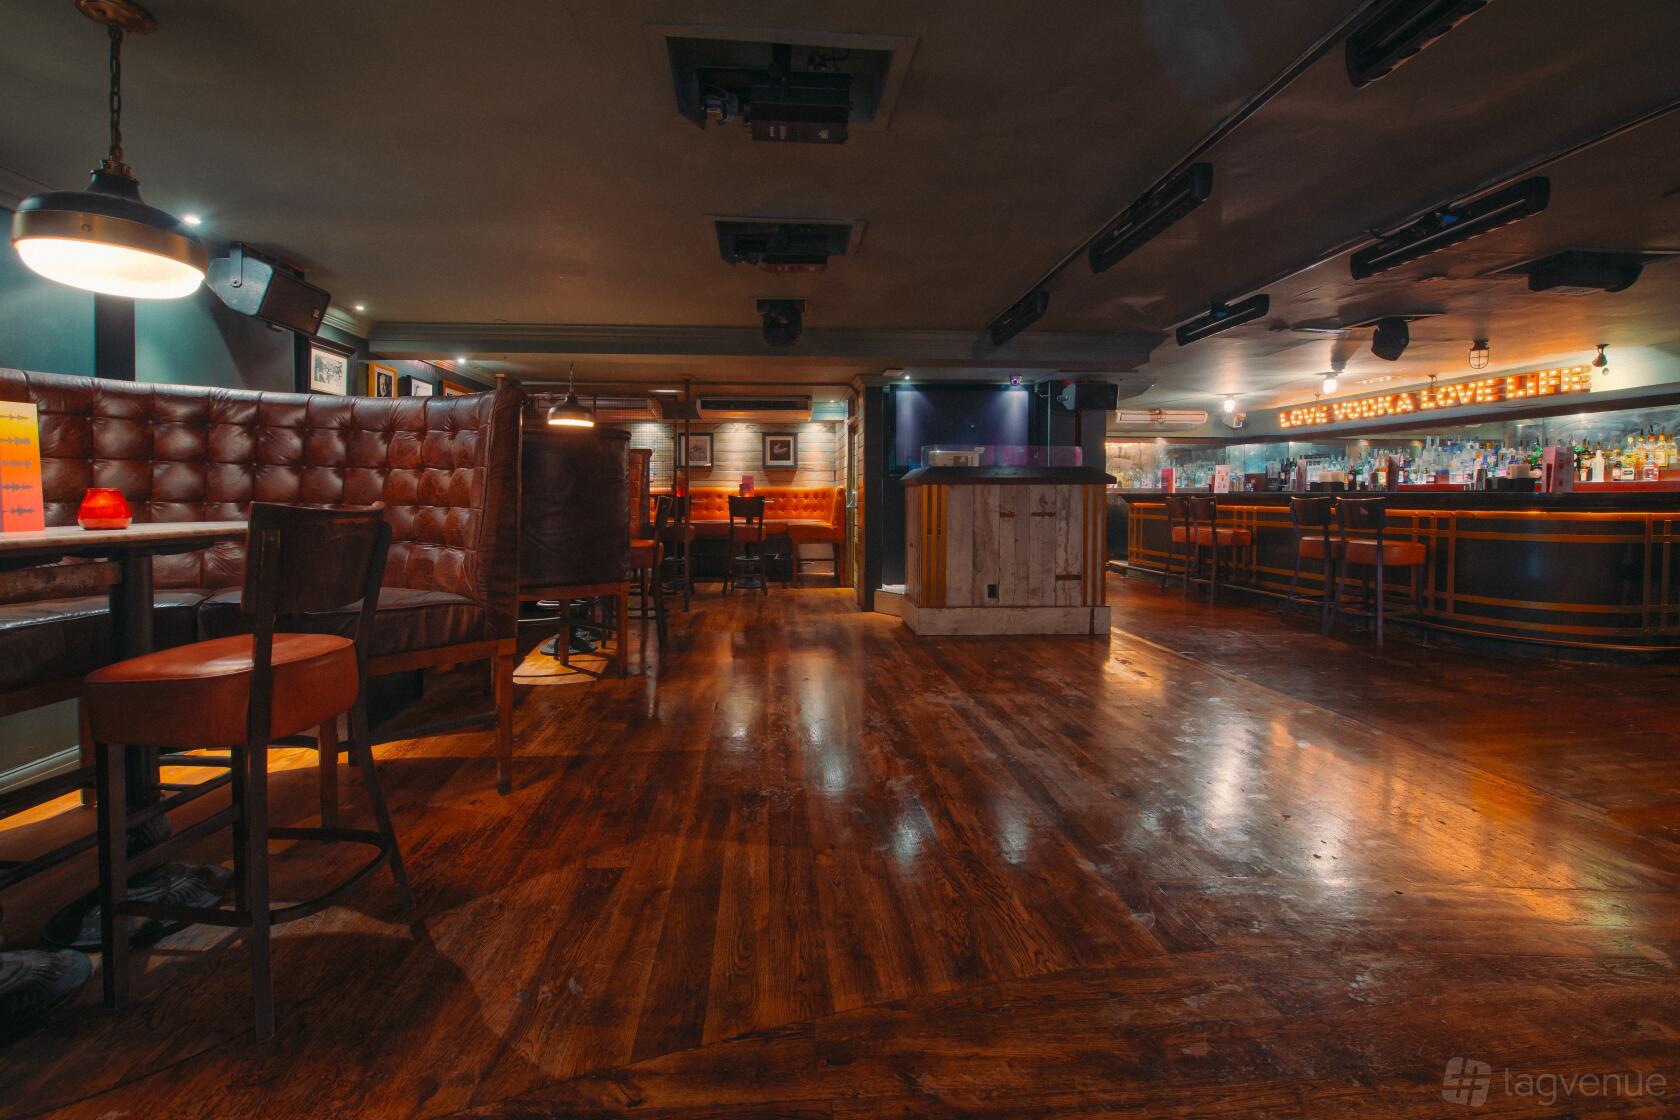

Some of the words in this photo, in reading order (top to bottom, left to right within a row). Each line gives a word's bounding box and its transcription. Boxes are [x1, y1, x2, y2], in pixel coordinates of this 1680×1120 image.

[1279, 405, 1330, 428] LOVE
[1333, 391, 1415, 421] VODKA
[1421, 378, 1499, 410] LOVE
[1506, 365, 1591, 398] LIFE
